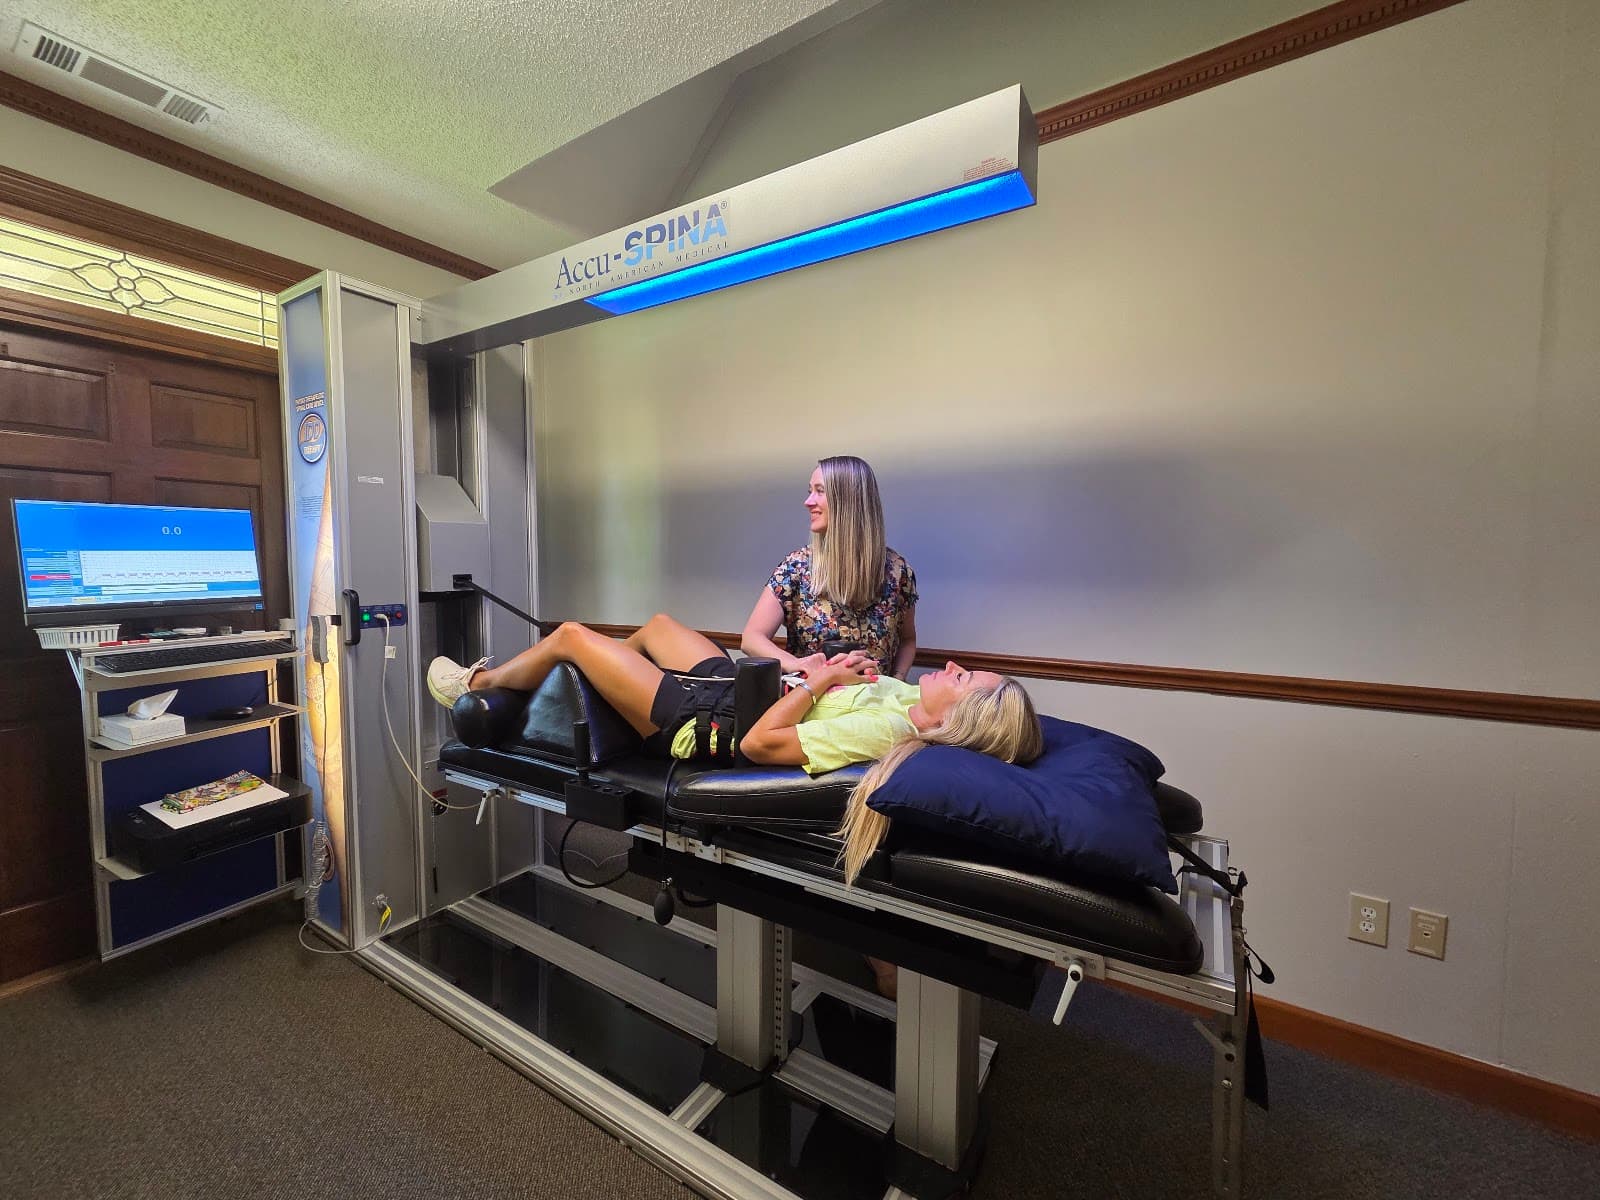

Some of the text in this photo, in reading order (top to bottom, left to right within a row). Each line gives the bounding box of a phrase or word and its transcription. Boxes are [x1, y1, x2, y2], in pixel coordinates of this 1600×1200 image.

[569, 241, 729, 294] NORTH AMERICAN MEDICAL
[161, 526, 182, 535] 0.0
